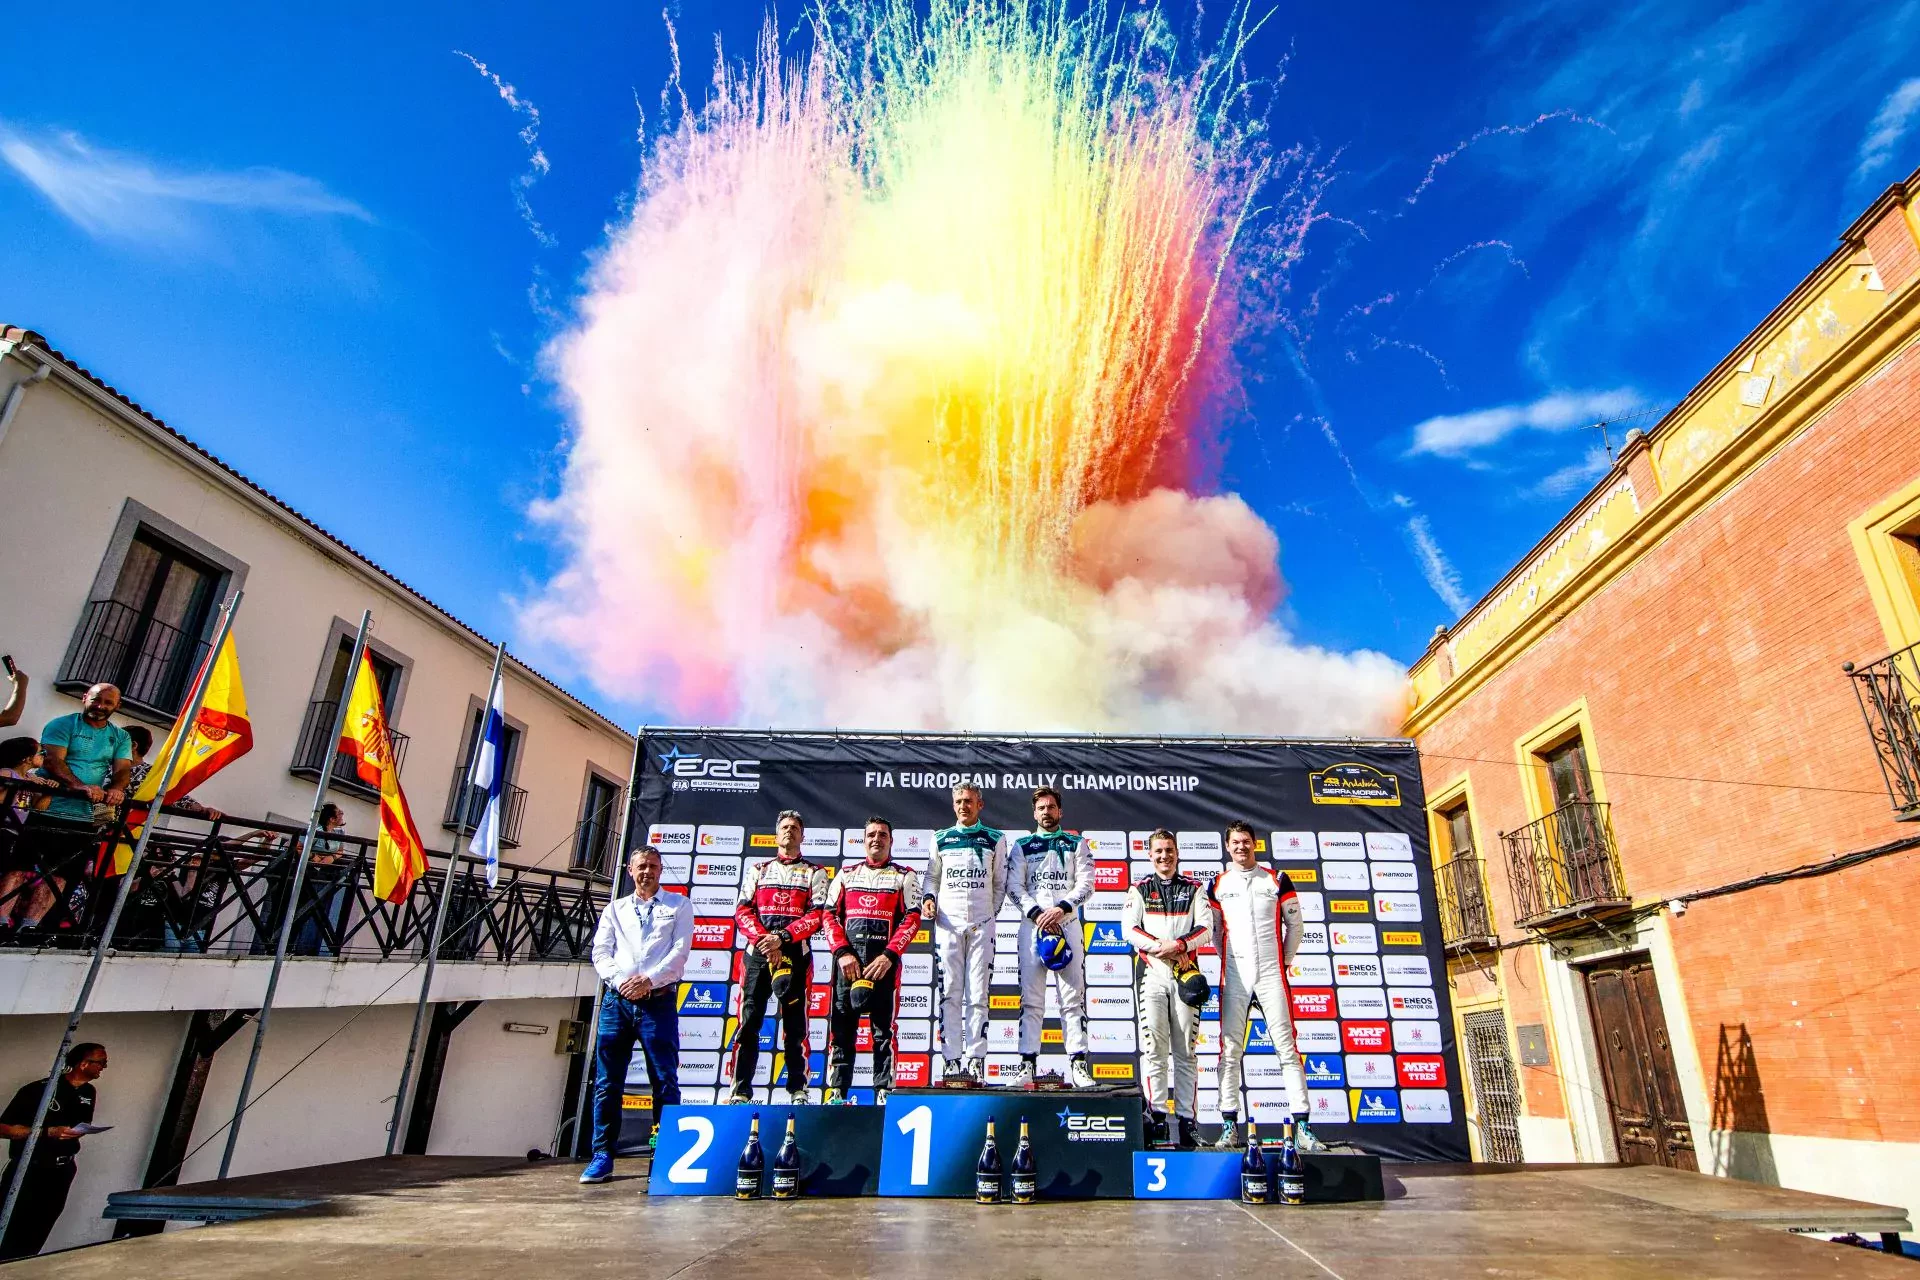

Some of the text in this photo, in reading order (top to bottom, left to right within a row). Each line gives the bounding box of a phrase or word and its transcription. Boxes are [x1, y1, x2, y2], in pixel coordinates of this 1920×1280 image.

[674, 758, 760, 778] ERC
[672, 779, 689, 791] FIA
[866, 772, 1199, 791] FIA EUROPEAN RALLY CHAMPIONSHIP
[946, 868, 987, 879] Recalvi
[1031, 871, 1068, 883] Recalvi
[694, 926, 731, 934] MRF
[1294, 995, 1330, 1004] MRF
[1348, 1028, 1385, 1037] MRF
[1353, 1038, 1382, 1046] TYRES
[1403, 1062, 1440, 1072] MRF
[1408, 1073, 1437, 1081] TYRES
[1067, 1116, 1125, 1130] ERC
[668, 1116, 714, 1183] 2
[897, 1105, 933, 1185] 1
[1147, 1158, 1167, 1191] 3
